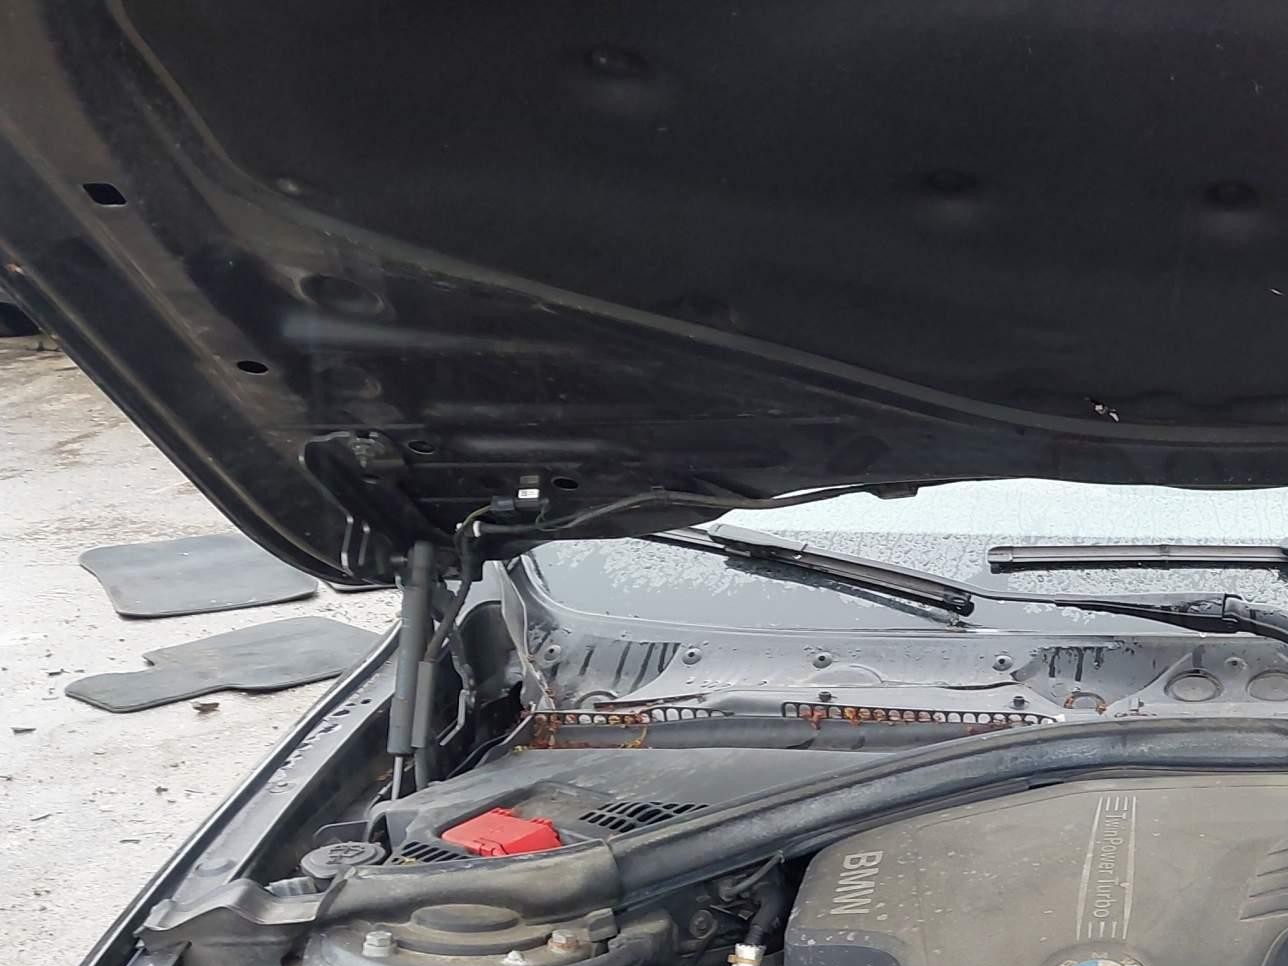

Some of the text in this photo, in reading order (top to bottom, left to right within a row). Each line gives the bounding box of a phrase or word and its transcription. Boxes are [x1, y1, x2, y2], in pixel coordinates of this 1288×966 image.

[830, 851, 883, 915] BMW
[1093, 811, 1127, 918] TwinPower Turbo
